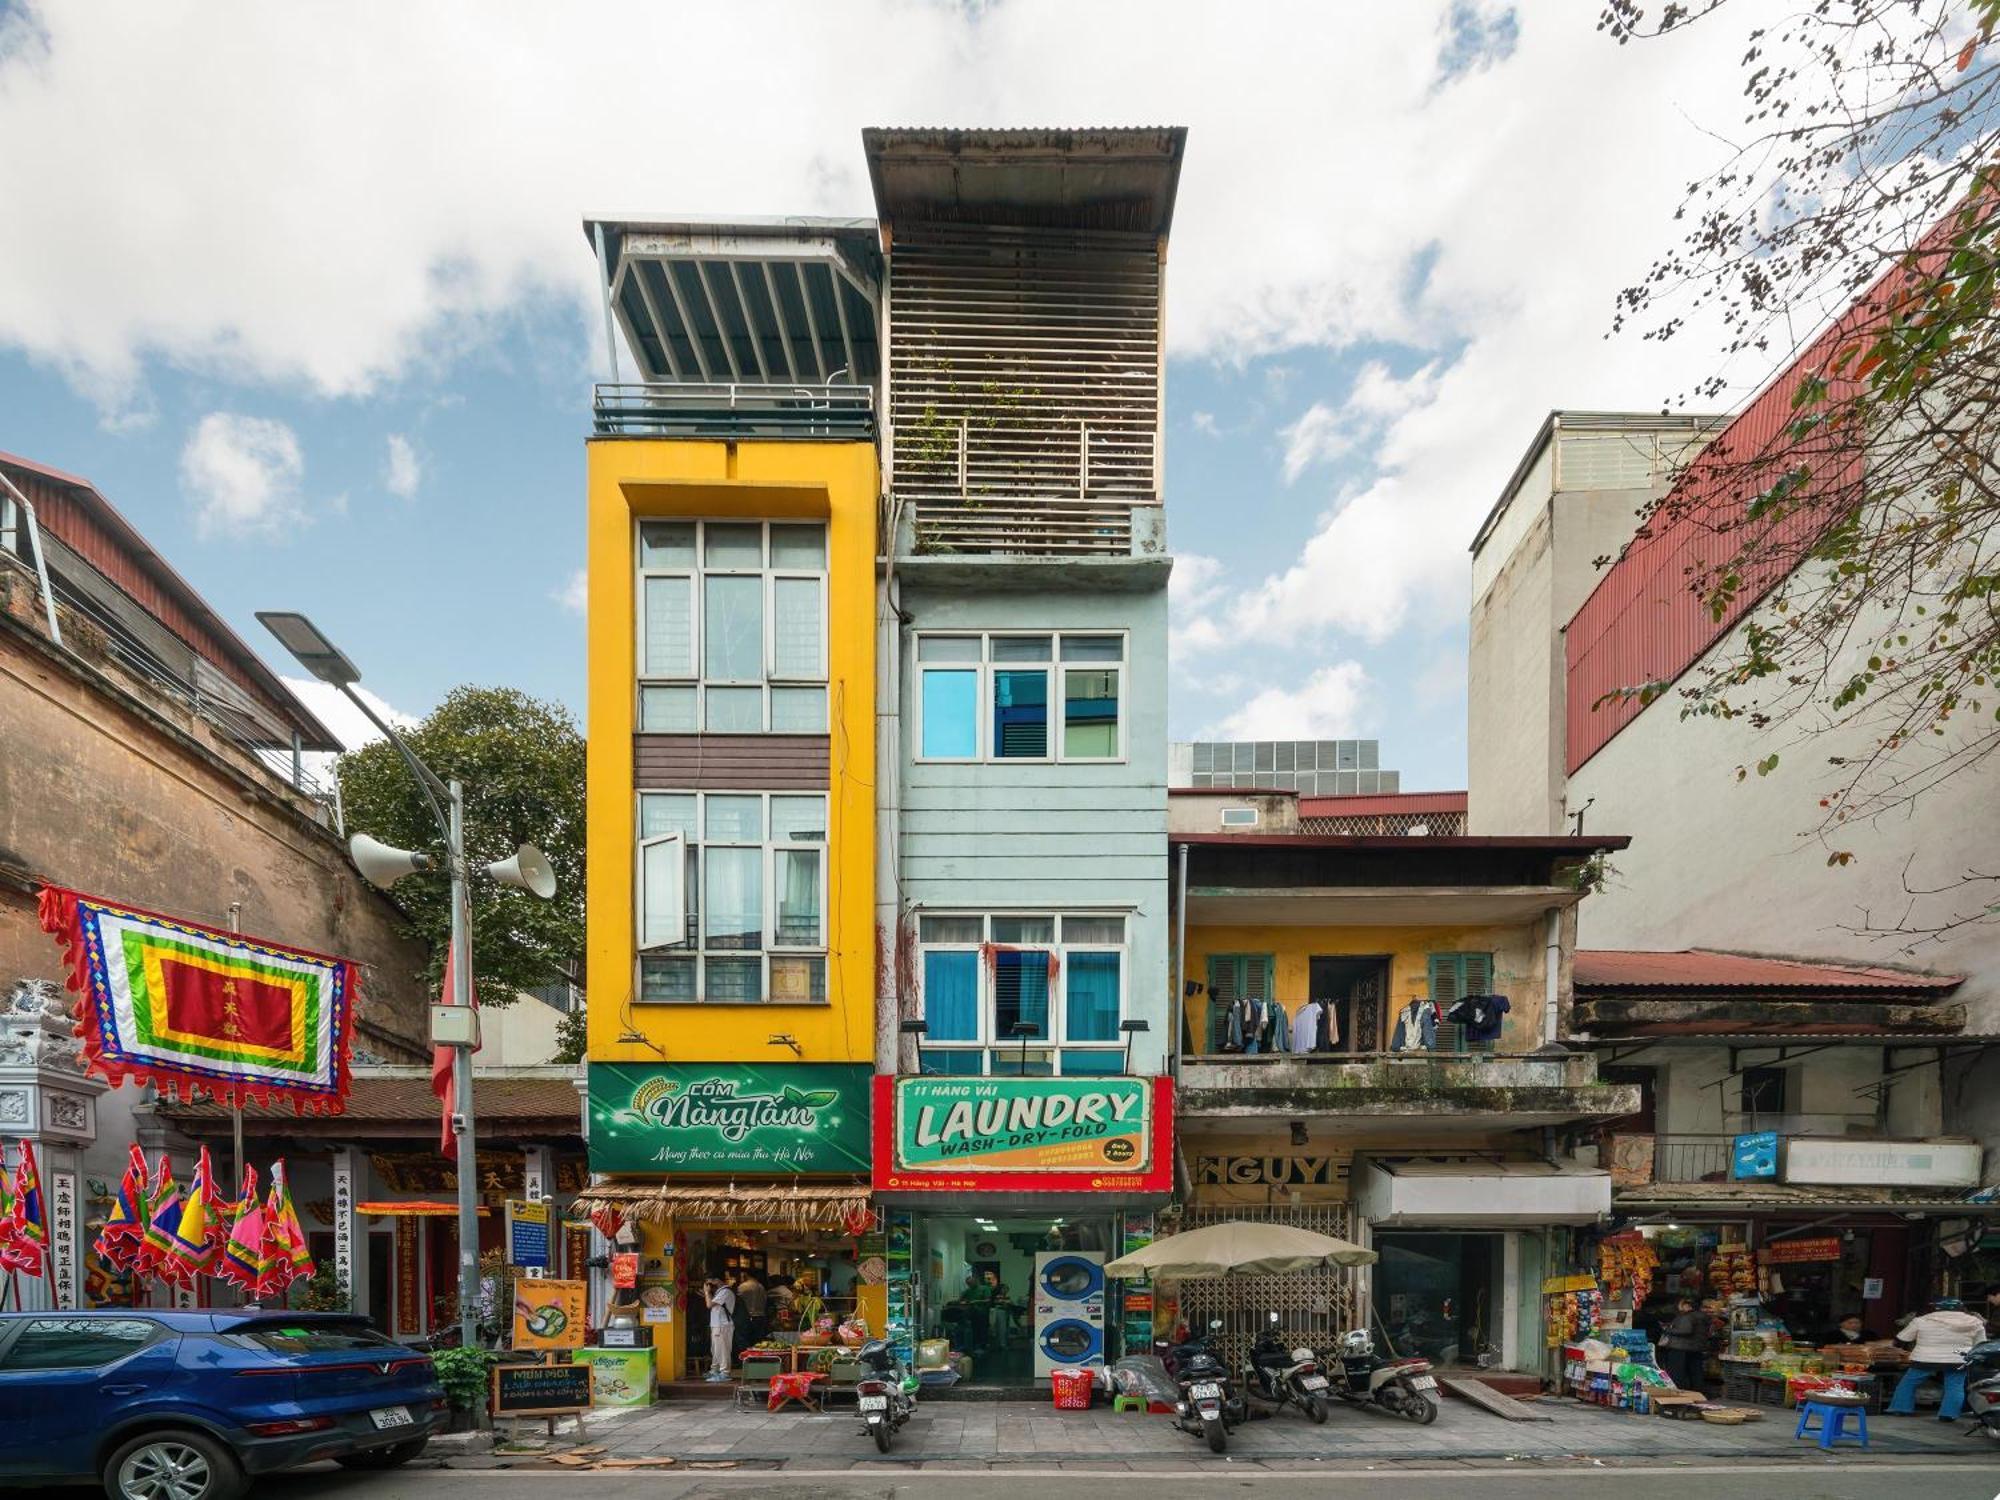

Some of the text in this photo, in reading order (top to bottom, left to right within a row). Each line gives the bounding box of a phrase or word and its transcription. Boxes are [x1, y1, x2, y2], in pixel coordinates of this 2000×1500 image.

[914, 1085, 929, 1096] 11
[931, 1083, 971, 1096] HÀNG
[916, 1092, 1139, 1147] LAUNDRY
[650, 1146, 688, 1163] Mang
[689, 1146, 711, 1160] theo
